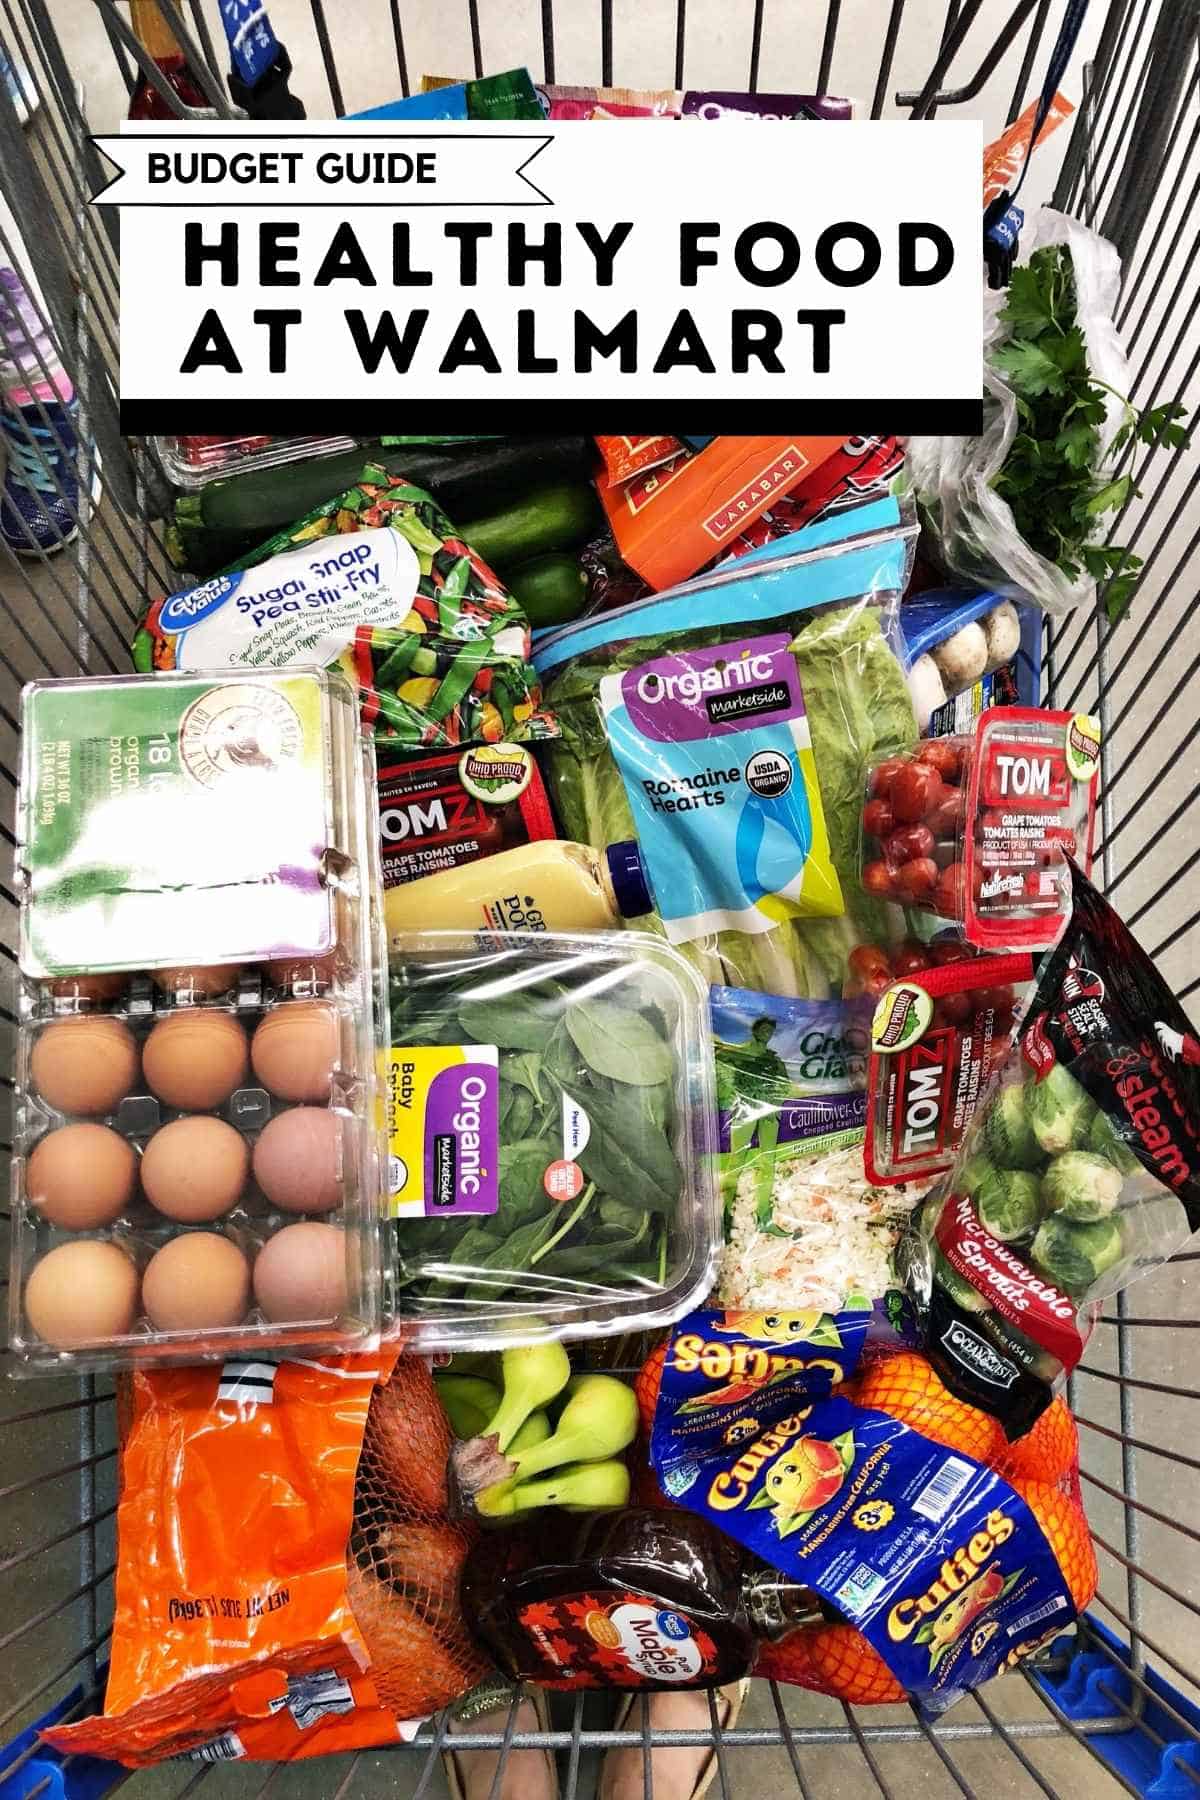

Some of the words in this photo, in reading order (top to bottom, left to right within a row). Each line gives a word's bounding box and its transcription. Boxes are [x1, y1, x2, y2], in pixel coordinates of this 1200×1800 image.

[715, 459, 795, 530] LARABAR
[236, 576, 306, 613] Sugar
[310, 543, 372, 579] Snap
[168, 575, 229, 617] Great
[182, 580, 232, 616] Value
[251, 598, 300, 628] Pea
[304, 563, 381, 608] Stir-Fry
[637, 651, 774, 706] Organic
[56, 740, 71, 758] NET
[147, 731, 172, 765] 18
[56, 760, 71, 776] WT
[56, 777, 70, 790] 36
[468, 760, 490, 776] OHIO
[491, 761, 524, 777] PROUD
[642, 766, 741, 798] Romaine
[753, 760, 782, 775] USDA
[753, 773, 788, 790] ORGANIC
[56, 791, 71, 804] OZ
[650, 789, 727, 815] Hearts
[379, 796, 478, 842] OMZ
[382, 853, 418, 871] RAPE
[416, 841, 479, 863] TOMATOES
[382, 863, 409, 881] ATES
[409, 856, 456, 876] RAISINS
[892, 994, 909, 1026] PROUD
[1067, 1007, 1087, 1037] STEAM
[1077, 1002, 1092, 1025] SEAL
[957, 1036, 973, 1095] TOMATOES
[968, 1059, 981, 1101] RAISINS
[398, 1063, 415, 1109] Baby
[953, 1095, 966, 1129] GRAPE
[452, 1076, 487, 1196] Organic
[572, 1130, 580, 1147] Here
[1116, 1073, 1192, 1188] steam
[956, 1197, 1074, 1320] Microwavable
[947, 1249, 983, 1291] BRUSSELS
[983, 1288, 1021, 1326] SPROUTS
[957, 1240, 1031, 1312] Sprouts
[798, 1507, 846, 1560] MANDARINS
[850, 1443, 893, 1495] CALIFORNIA
[859, 1508, 876, 1526] 3
[851, 1565, 867, 1583] NON
[888, 1508, 1015, 1642] Cuties
[263, 1588, 291, 1610] NET
[629, 1619, 677, 1676] Maple
[636, 1651, 658, 1676] Syrup
[676, 1656, 693, 1674] Pure
